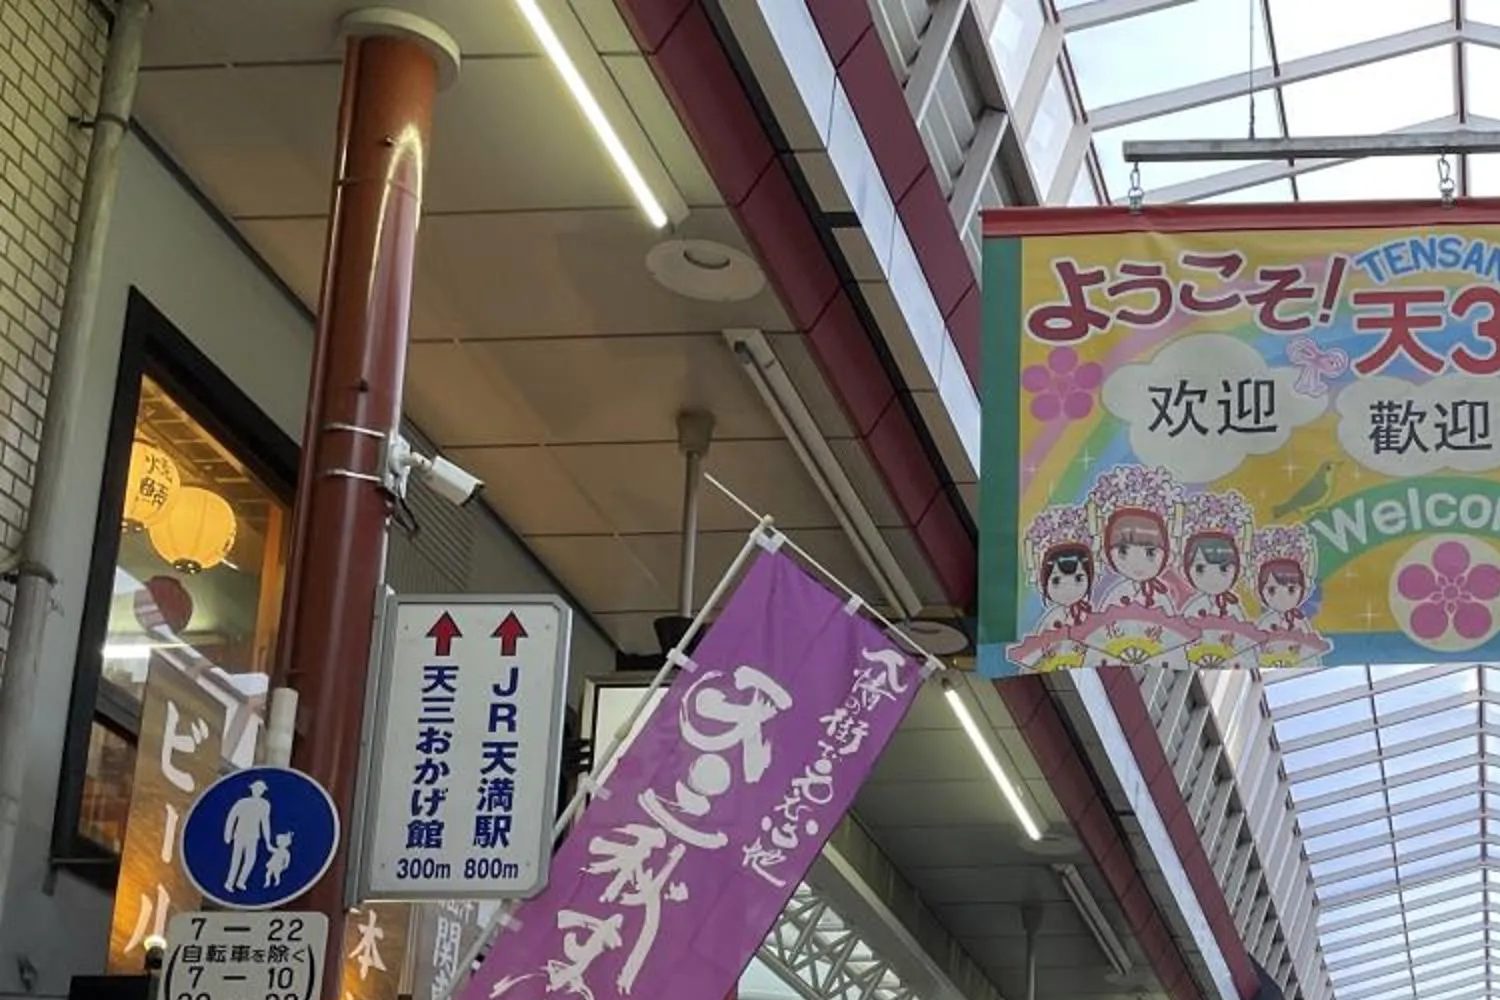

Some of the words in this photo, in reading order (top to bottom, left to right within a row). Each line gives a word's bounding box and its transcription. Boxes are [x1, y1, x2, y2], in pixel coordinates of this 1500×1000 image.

[1028, 253, 1348, 342] ようこそ!
[1148, 378, 1279, 438] 欢迎
[1368, 400, 1493, 455] 歡迎
[405, 664, 459, 850] 天三おかげ館
[472, 666, 519, 849] JR天満駅
[123, 700, 209, 953] ビール
[396, 857, 453, 880] 300m
[463, 857, 519, 880] 800m
[267, 918, 305, 942] 22
[268, 966, 294, 990] 10
